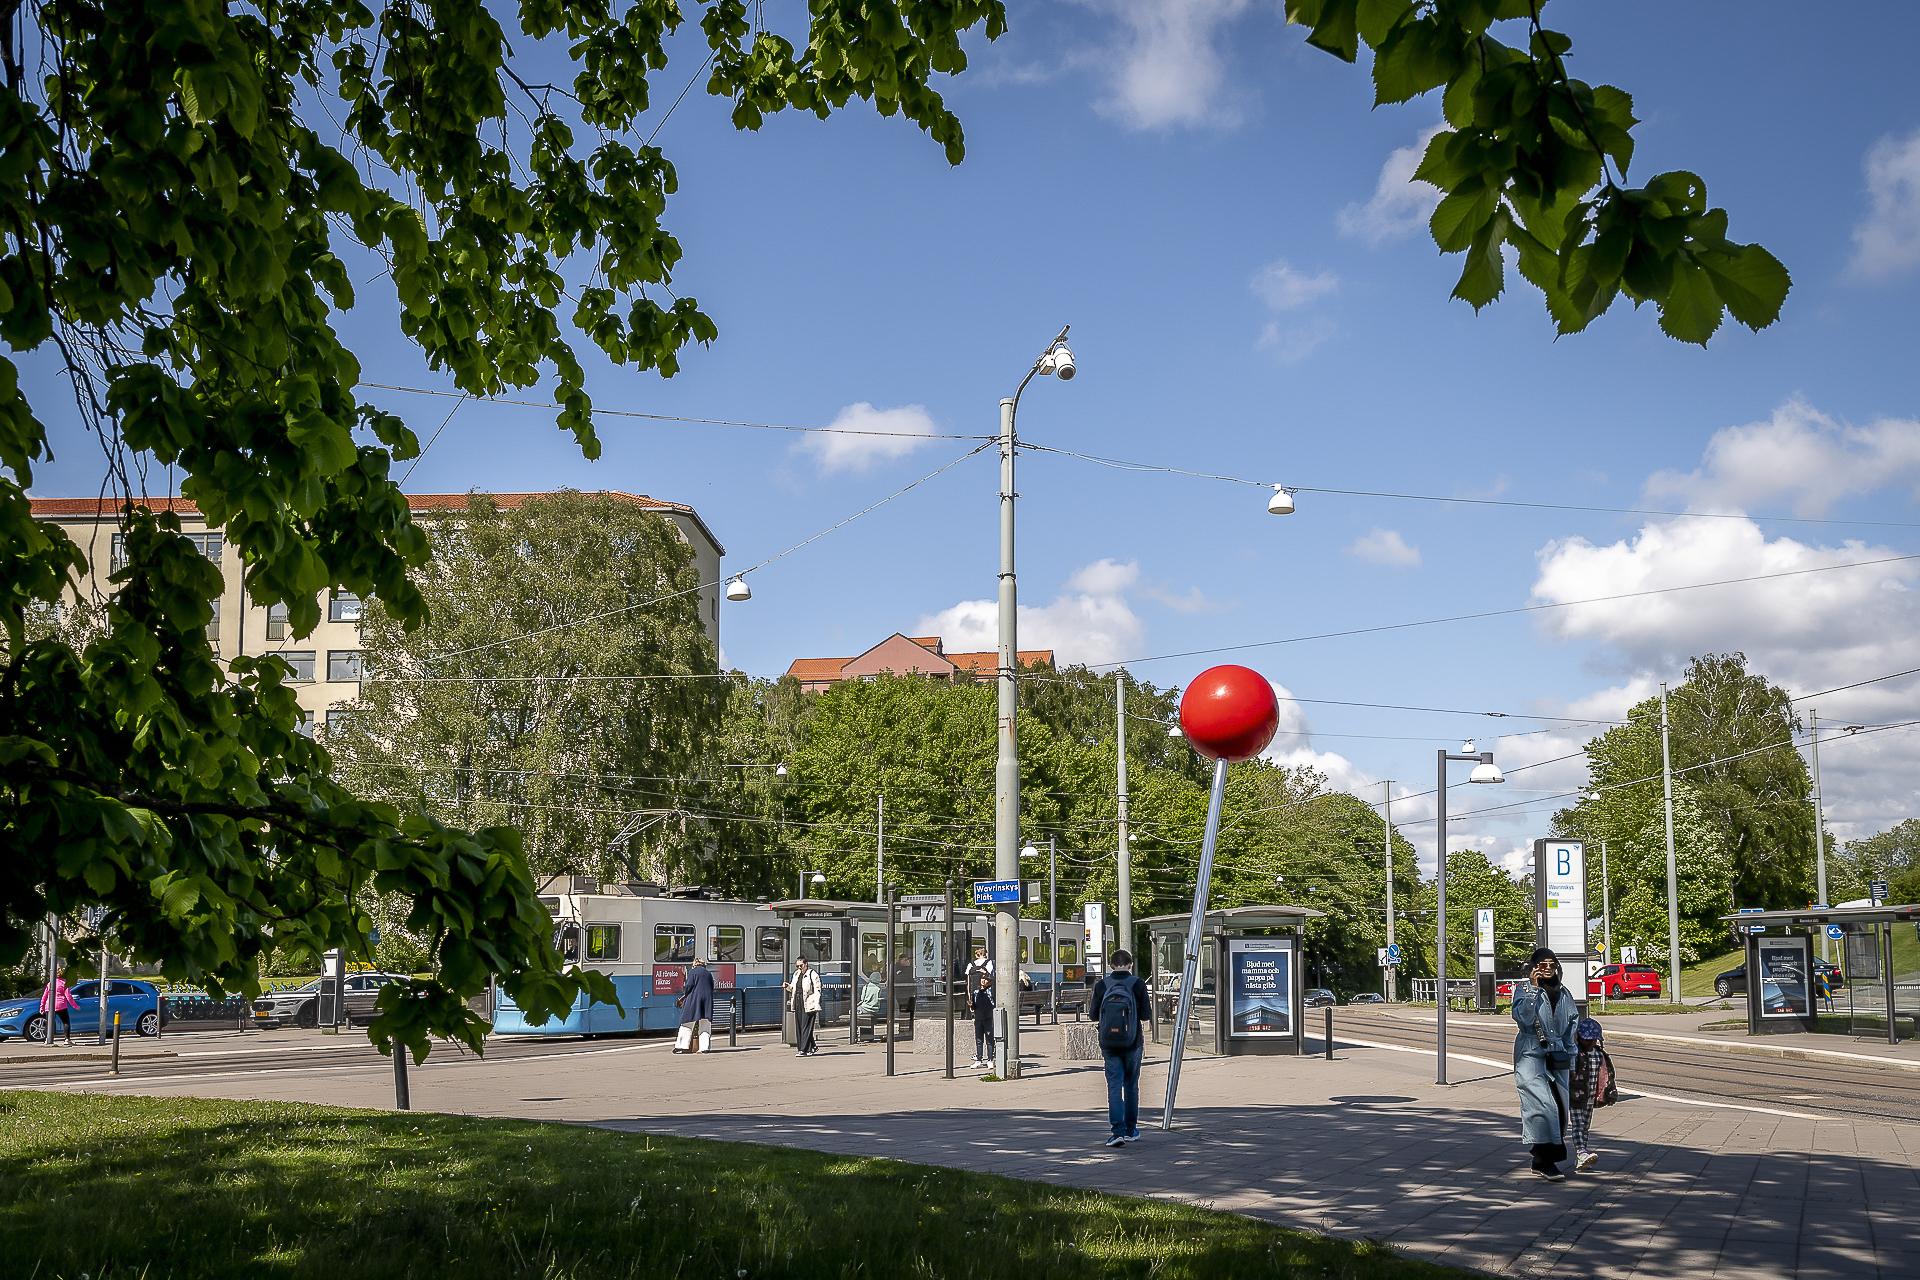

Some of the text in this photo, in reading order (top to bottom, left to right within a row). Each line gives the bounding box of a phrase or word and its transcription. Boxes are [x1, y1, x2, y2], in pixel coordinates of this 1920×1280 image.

[1557, 848, 1571, 876] B
[976, 884, 1018, 892] Wavrinskys
[1090, 906, 1097, 920] C
[1482, 911, 1489, 923] A
[1246, 960, 1275, 969] Bjud med
[1247, 974, 1275, 983] pappa på
[1262, 982, 1277, 990] gibb
